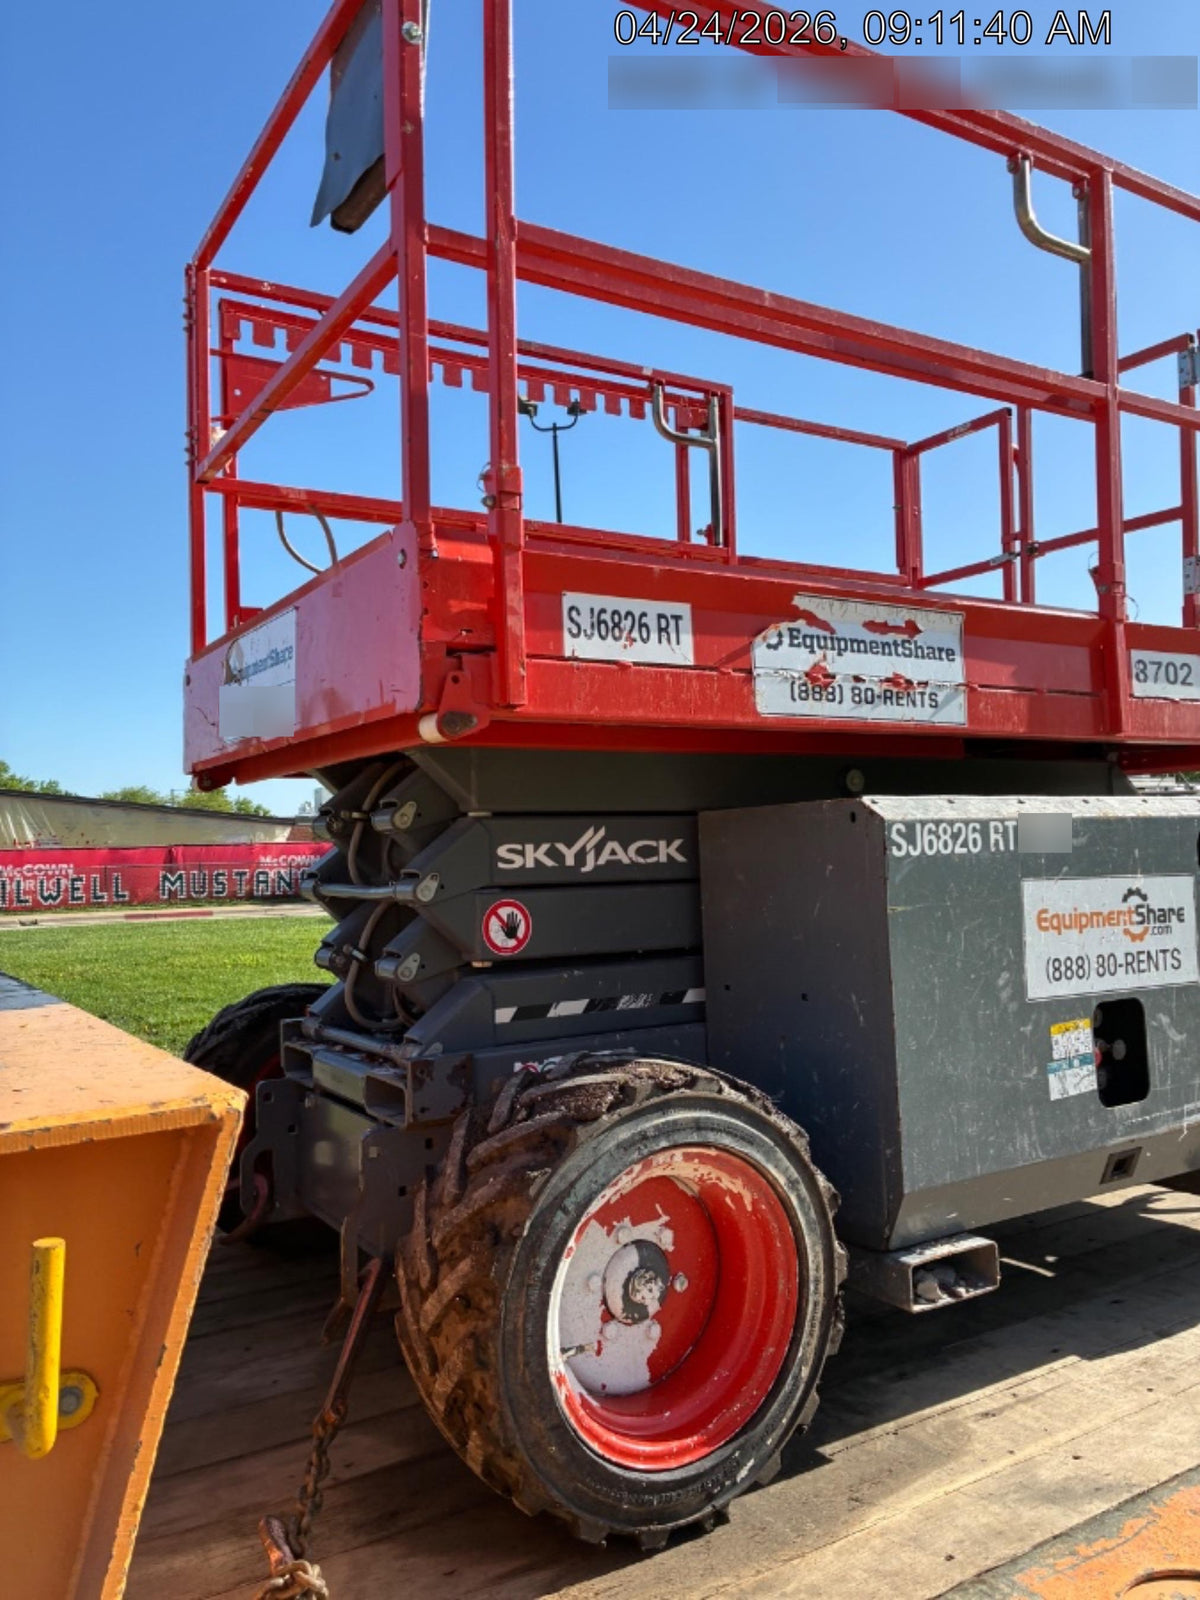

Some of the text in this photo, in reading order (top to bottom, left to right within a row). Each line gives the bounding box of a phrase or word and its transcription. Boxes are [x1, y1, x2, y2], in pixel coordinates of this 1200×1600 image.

[566, 605, 683, 646] SJ6826 RT
[787, 627, 957, 663] EquipmentShare
[1134, 658, 1195, 687] 8702
[789, 680, 940, 710] (888) 80-RENTS
[496, 826, 687, 872] SKYJACK
[890, 820, 1018, 857] SJ6826 RT
[1036, 904, 1185, 936] EquipmentShare
[1045, 947, 1182, 984] (888) 80-RENTS
